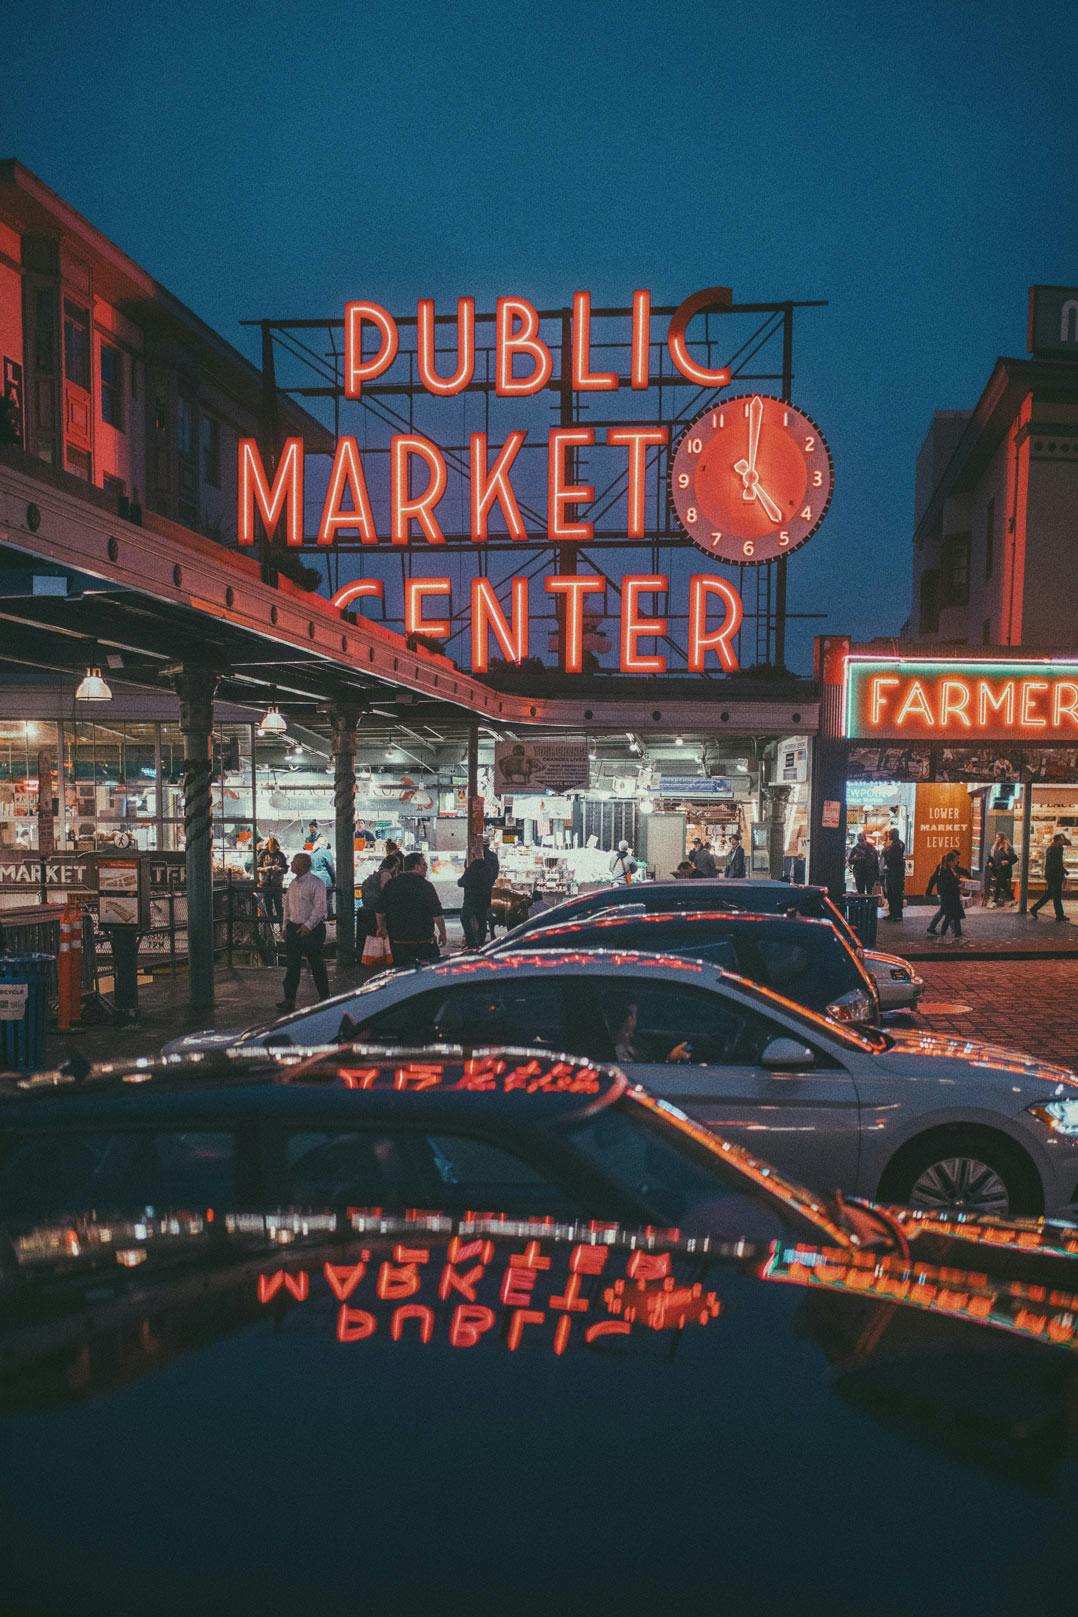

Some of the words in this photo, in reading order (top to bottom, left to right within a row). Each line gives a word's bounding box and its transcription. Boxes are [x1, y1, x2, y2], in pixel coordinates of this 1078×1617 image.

[345, 287, 733, 399] PUBLIC
[687, 438, 703, 454] 10
[804, 437, 815, 452] 2
[238, 427, 669, 546] MARKET
[678, 474, 690, 489] 9
[812, 471, 823, 487] 3
[686, 507, 698, 523] 8
[800, 506, 813, 521] 4
[711, 533, 722, 546] 7
[779, 532, 790, 546] 5
[743, 541, 754, 556] 6
[929, 807, 960, 819] LOWER
[927, 837, 960, 848] LEVELS
